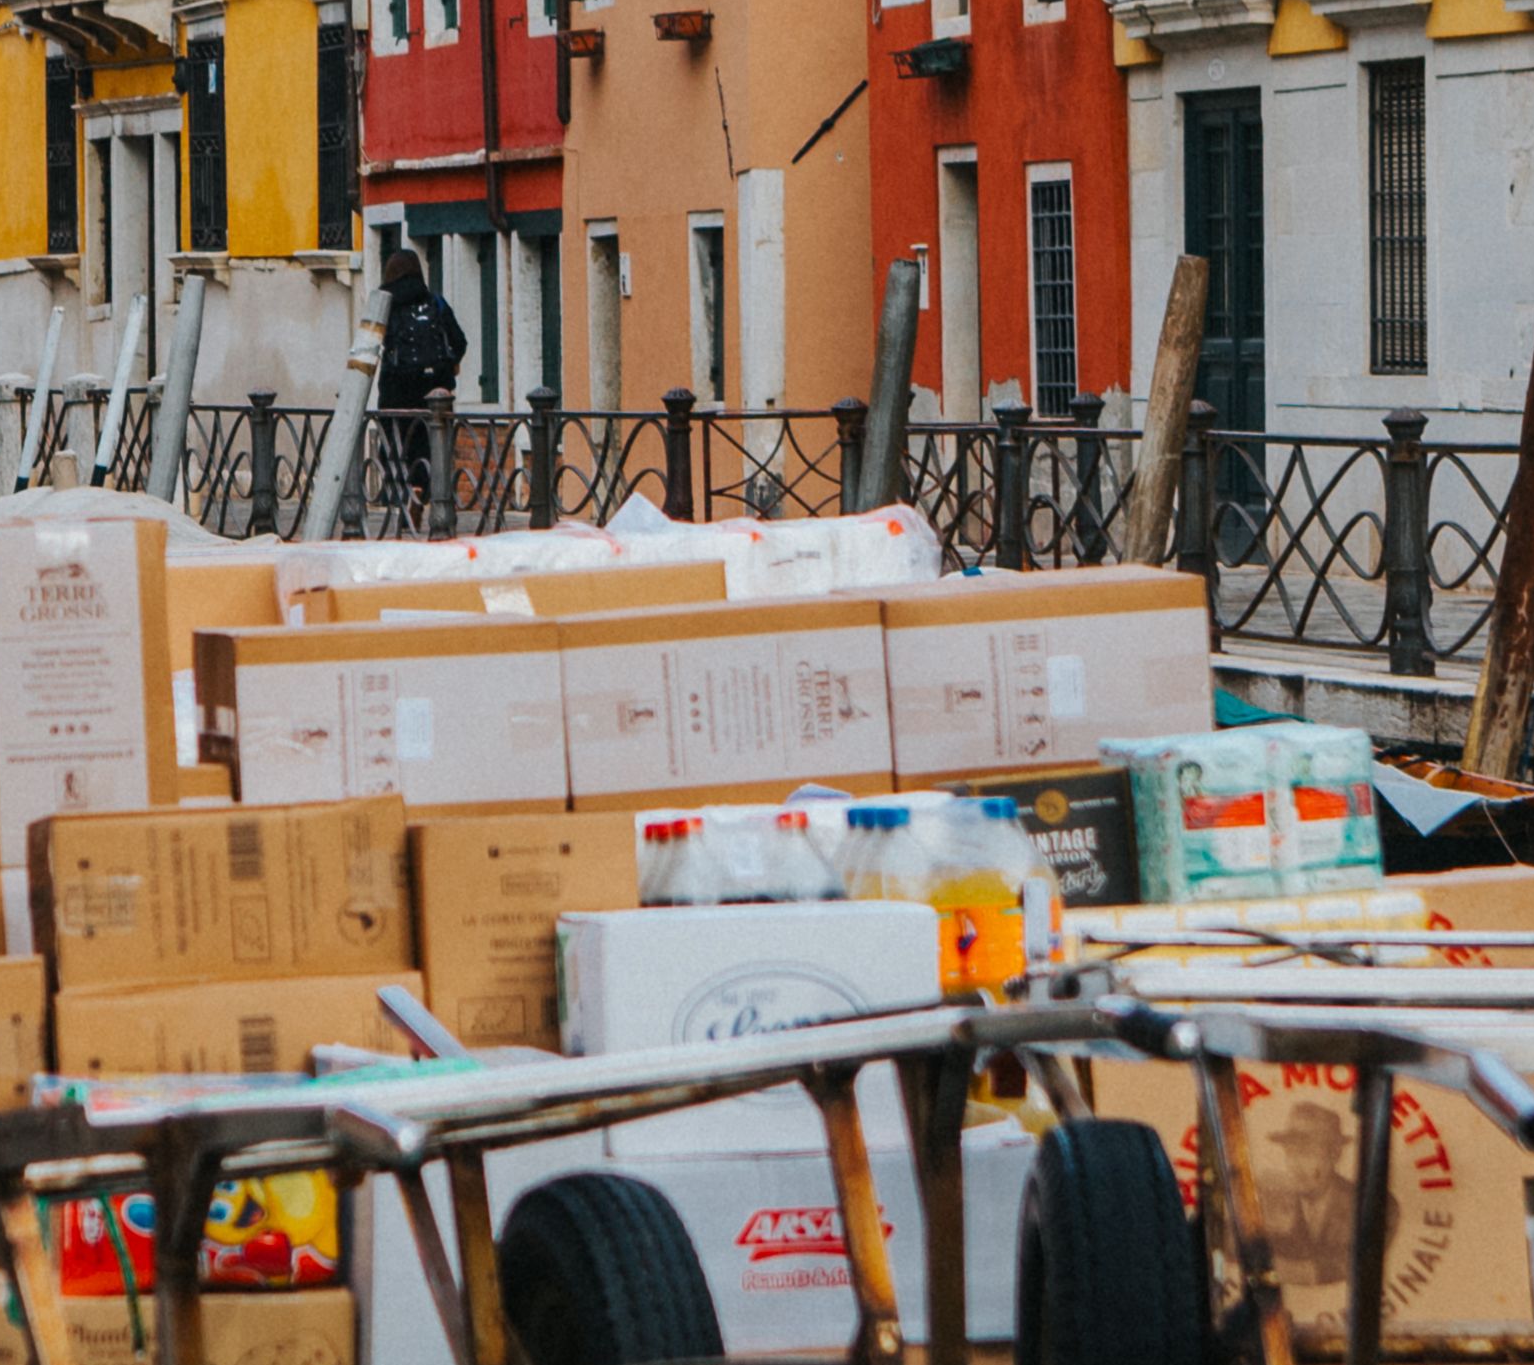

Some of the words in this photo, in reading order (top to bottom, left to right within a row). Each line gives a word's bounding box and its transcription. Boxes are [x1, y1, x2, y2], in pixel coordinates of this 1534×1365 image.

[25, 583, 104, 603] TERRE
[18, 603, 109, 622] GROSSE
[1281, 1062, 1454, 1190] MOETTI
